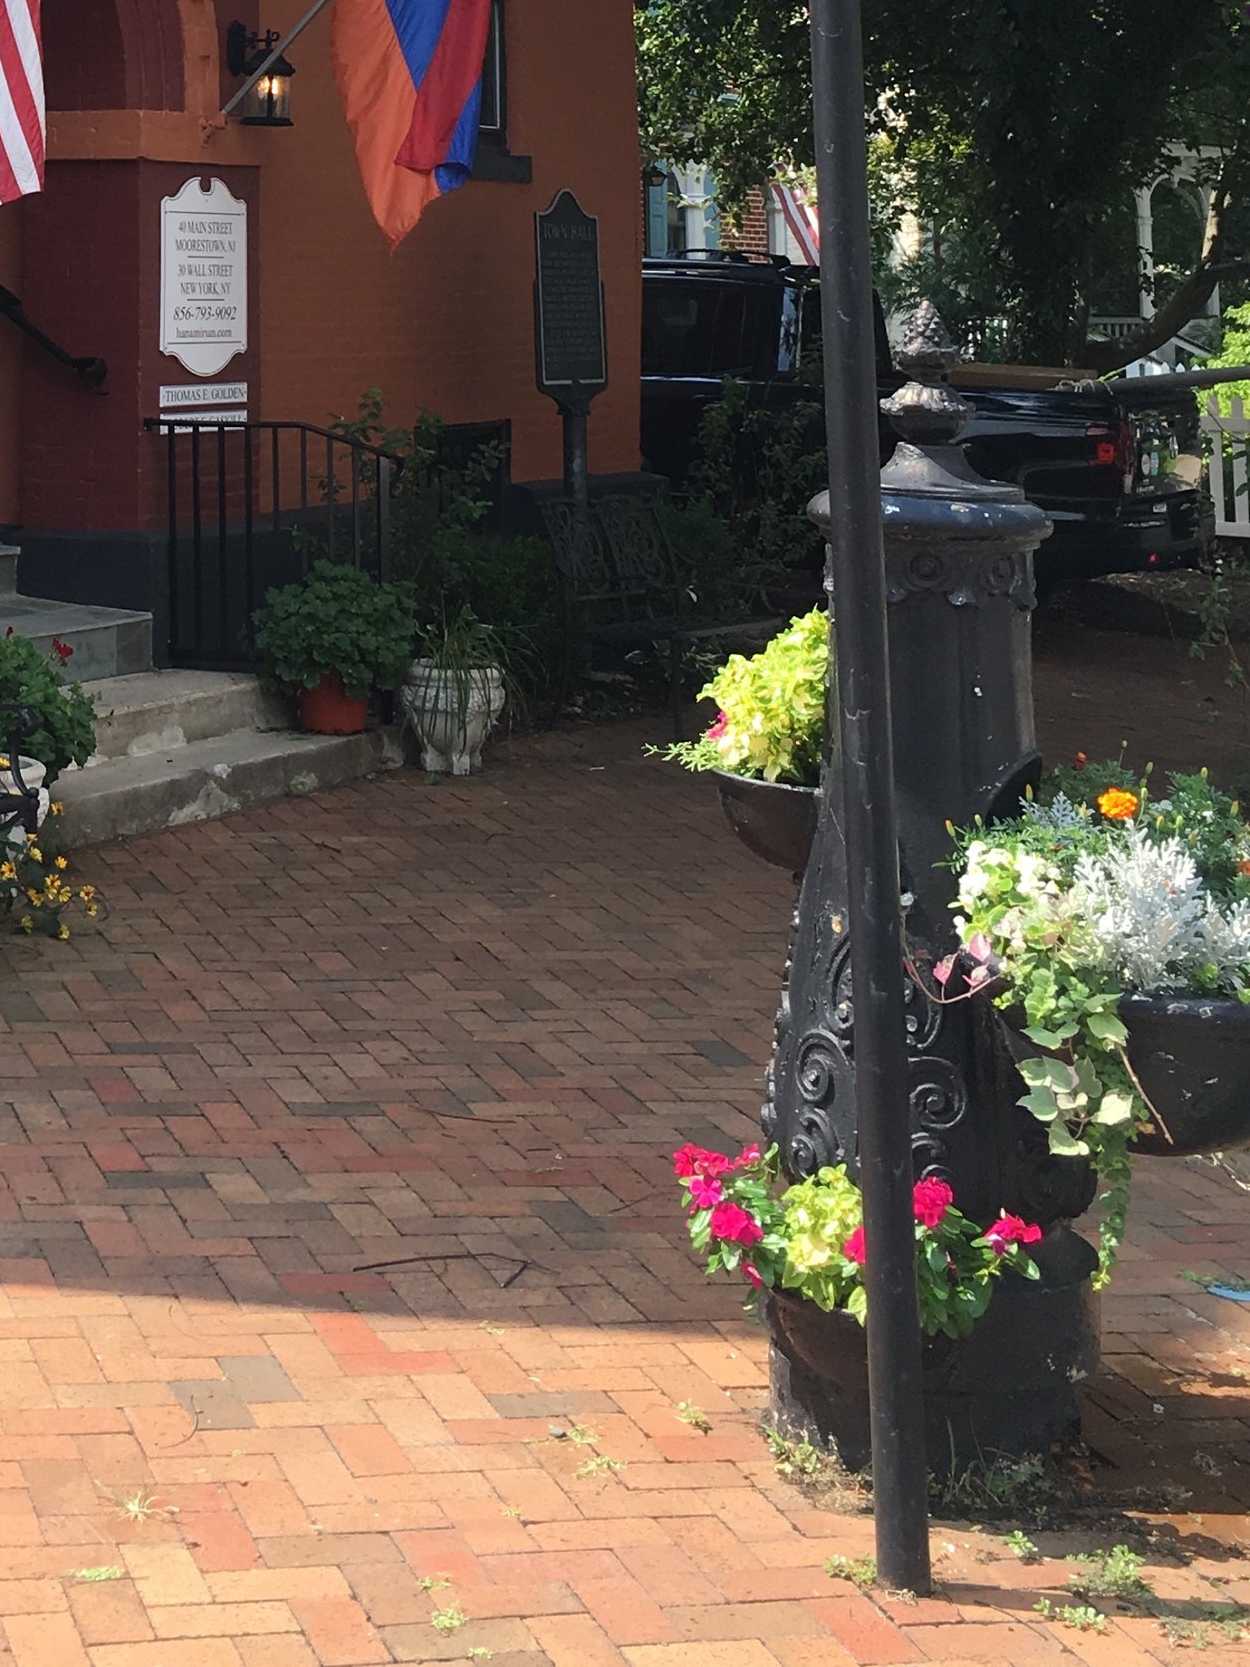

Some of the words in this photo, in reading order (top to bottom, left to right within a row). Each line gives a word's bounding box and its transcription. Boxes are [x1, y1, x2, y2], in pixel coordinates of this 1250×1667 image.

[187, 221, 207, 234] MAIN
[208, 221, 233, 235] STREET
[187, 264, 207, 277] WALL
[208, 264, 233, 277] STREET
[180, 281, 197, 295] NEW
[221, 282, 231, 295] NY
[173, 305, 237, 322] 856-793-9092
[166, 389, 201, 403] THOMAS
[211, 386, 245, 400] GOLDEN
